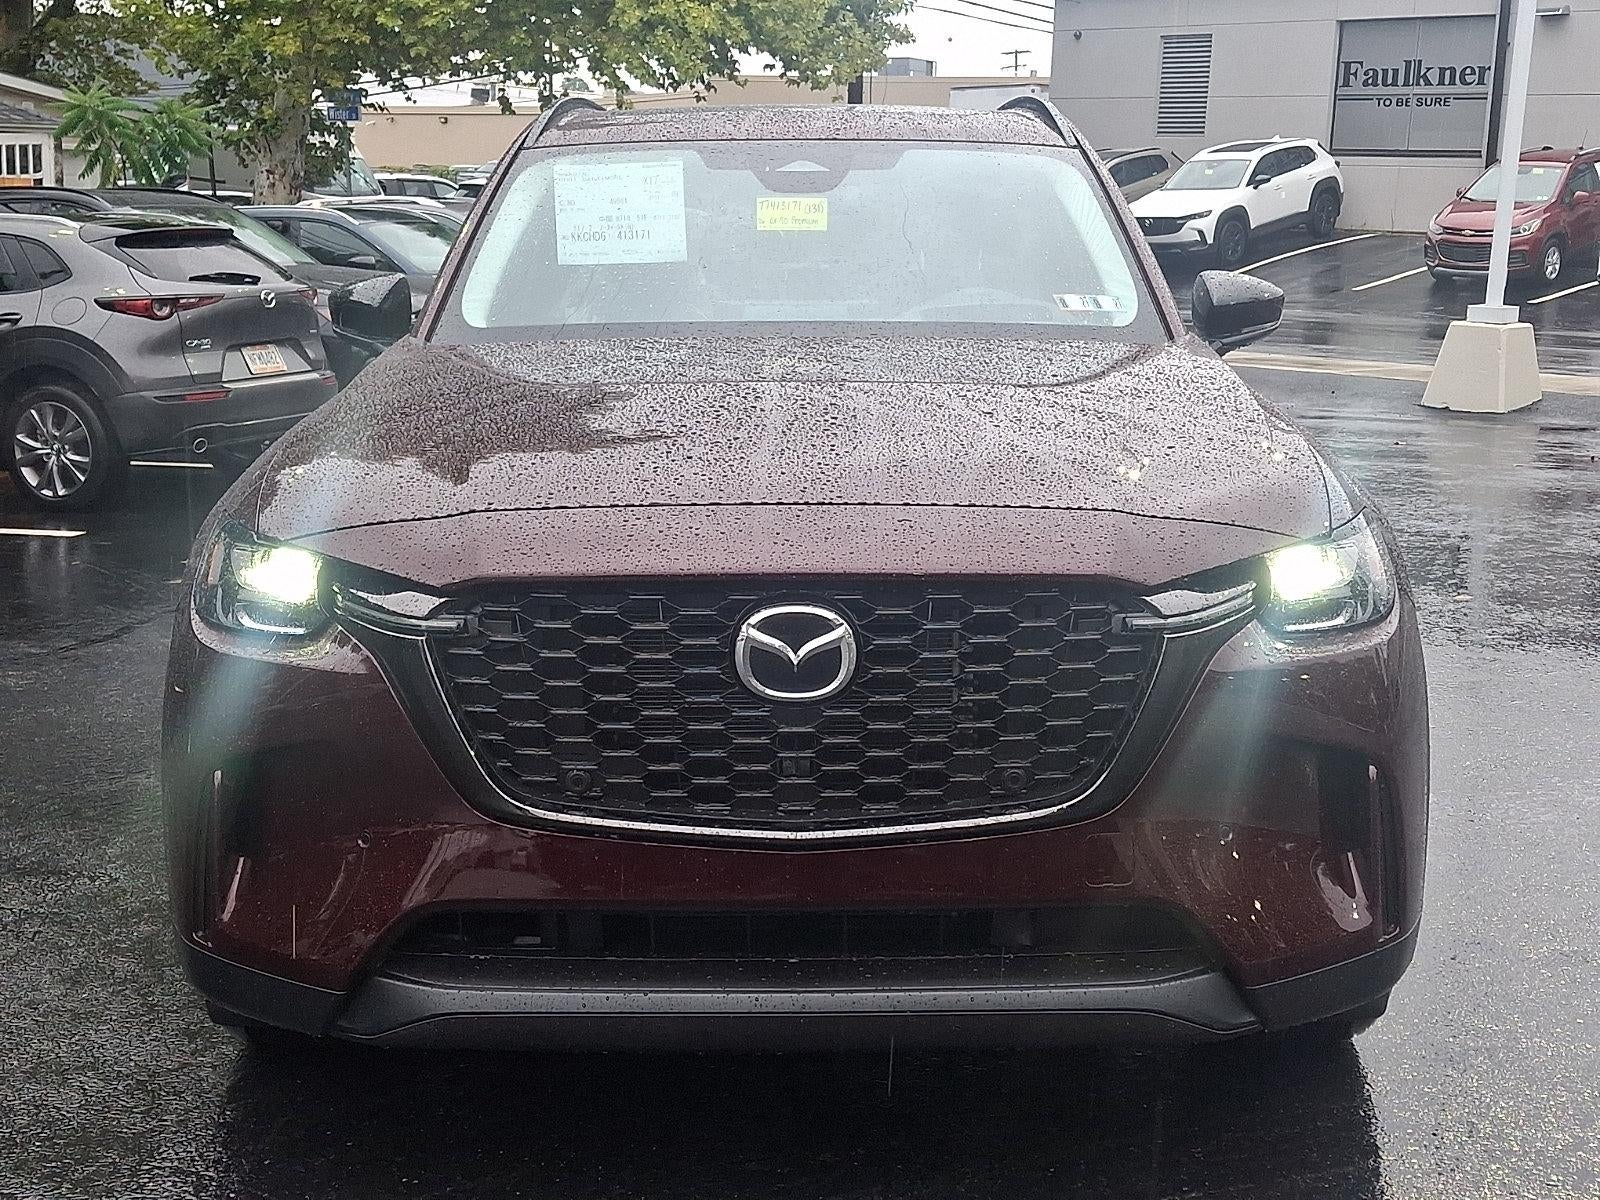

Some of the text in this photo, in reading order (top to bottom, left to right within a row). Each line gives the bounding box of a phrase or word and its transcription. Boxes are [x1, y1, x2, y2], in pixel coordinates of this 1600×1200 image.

[1339, 58, 1492, 88] Faulkner
[1375, 96, 1452, 108] TO BE SURE
[616, 229, 651, 240] 413171
